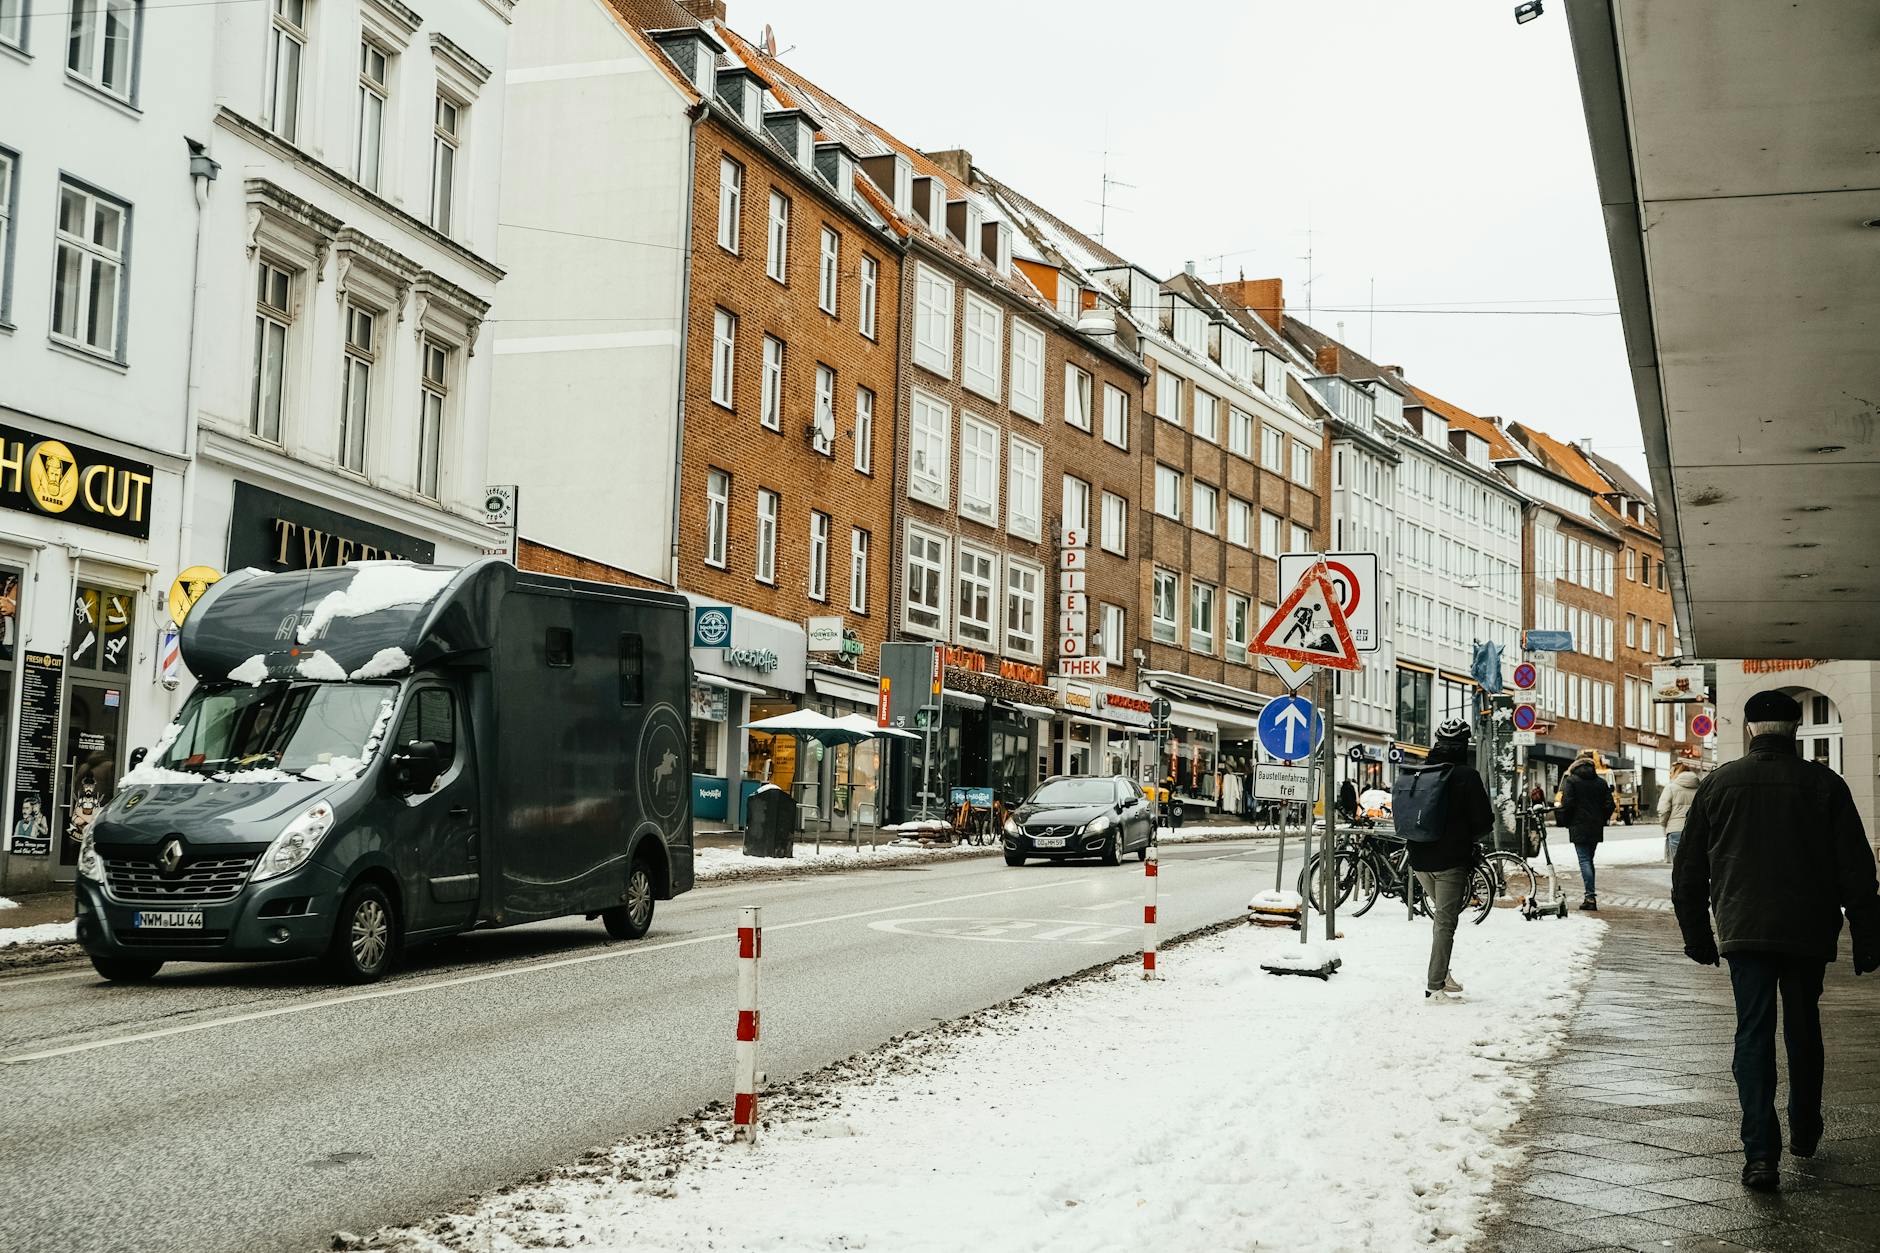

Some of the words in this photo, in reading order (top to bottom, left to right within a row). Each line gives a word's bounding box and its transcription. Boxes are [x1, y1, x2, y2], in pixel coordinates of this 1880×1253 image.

[84, 464, 151, 522] CUT
[41, 494, 64, 506] BARBER
[26, 655, 44, 664] FRESH
[52, 658, 63, 667] CUT
[1062, 660, 1101, 675] THEK
[1280, 784, 1296, 796] frei
[140, 913, 162, 926] NWM
[169, 914, 185, 926] LU
[187, 914, 202, 926] 44
